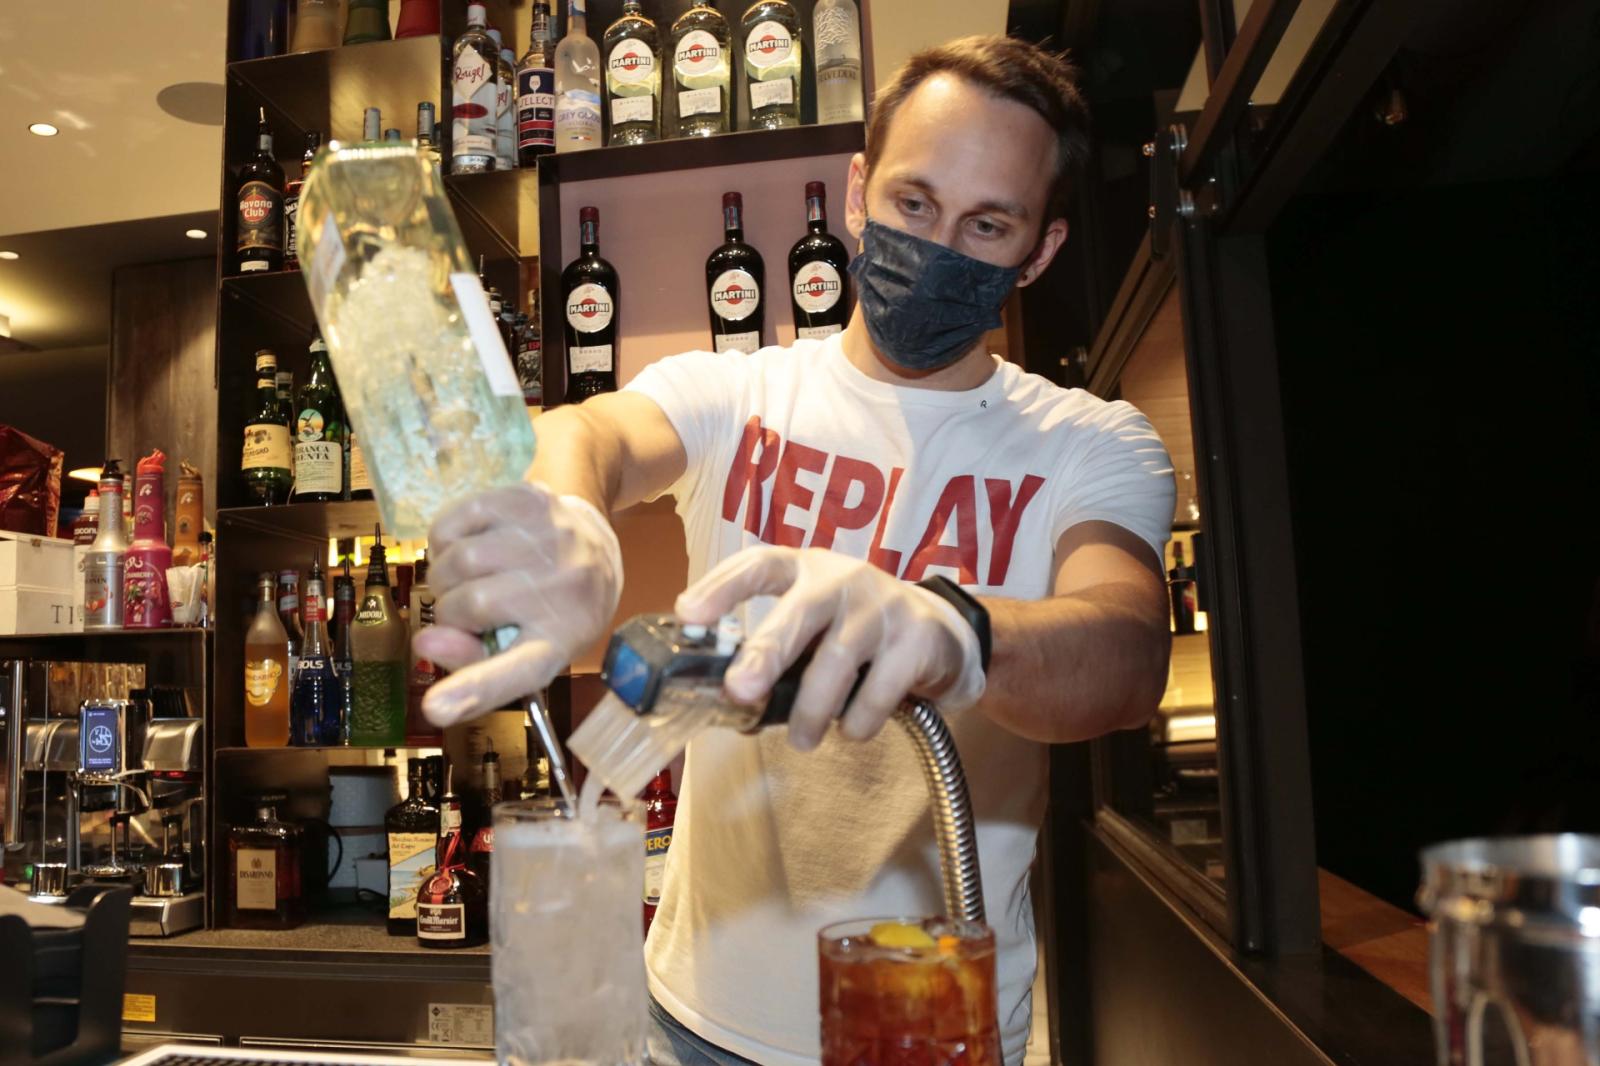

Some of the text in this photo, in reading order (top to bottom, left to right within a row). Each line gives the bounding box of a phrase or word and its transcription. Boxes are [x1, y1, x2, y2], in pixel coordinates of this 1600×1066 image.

[749, 38, 789, 53] MARTINI
[678, 48, 717, 61] MARTINI
[612, 57, 651, 69] MARTINI
[244, 208, 265, 217] Club
[797, 281, 838, 294] MARTINI
[715, 289, 756, 301] MARTINI
[570, 303, 609, 315] MARTINI
[722, 415, 1046, 586] REPLAY
[298, 660, 324, 669] BOLS
